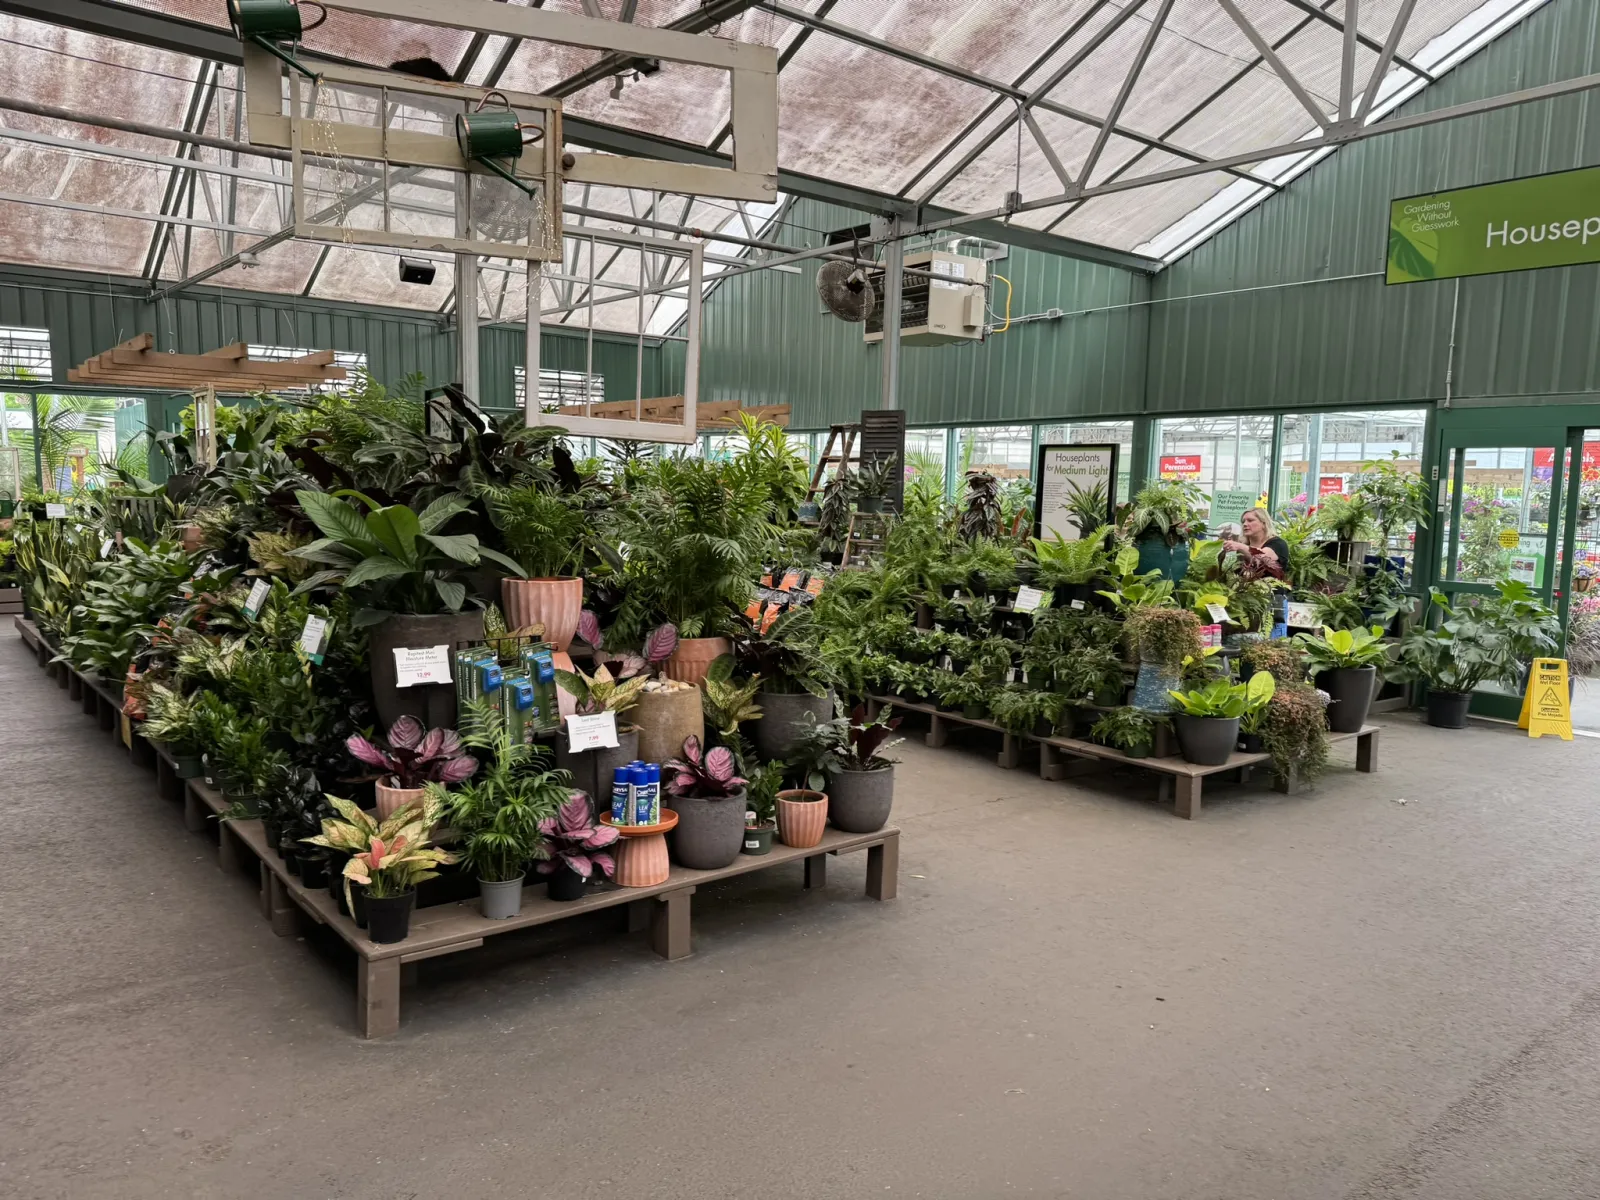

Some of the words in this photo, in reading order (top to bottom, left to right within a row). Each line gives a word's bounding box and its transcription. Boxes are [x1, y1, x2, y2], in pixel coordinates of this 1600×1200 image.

[1404, 200, 1451, 215] Gardening
[1417, 210, 1452, 223] Without
[1411, 217, 1460, 233] Guesswork
[1486, 216, 1600, 248] Housep
[1055, 452, 1100, 464] Houseplants
[1046, 463, 1054, 471] for
[1054, 464, 1086, 475] Medium
[1088, 464, 1108, 478] Light
[1164, 463, 1196, 471] Perennials
